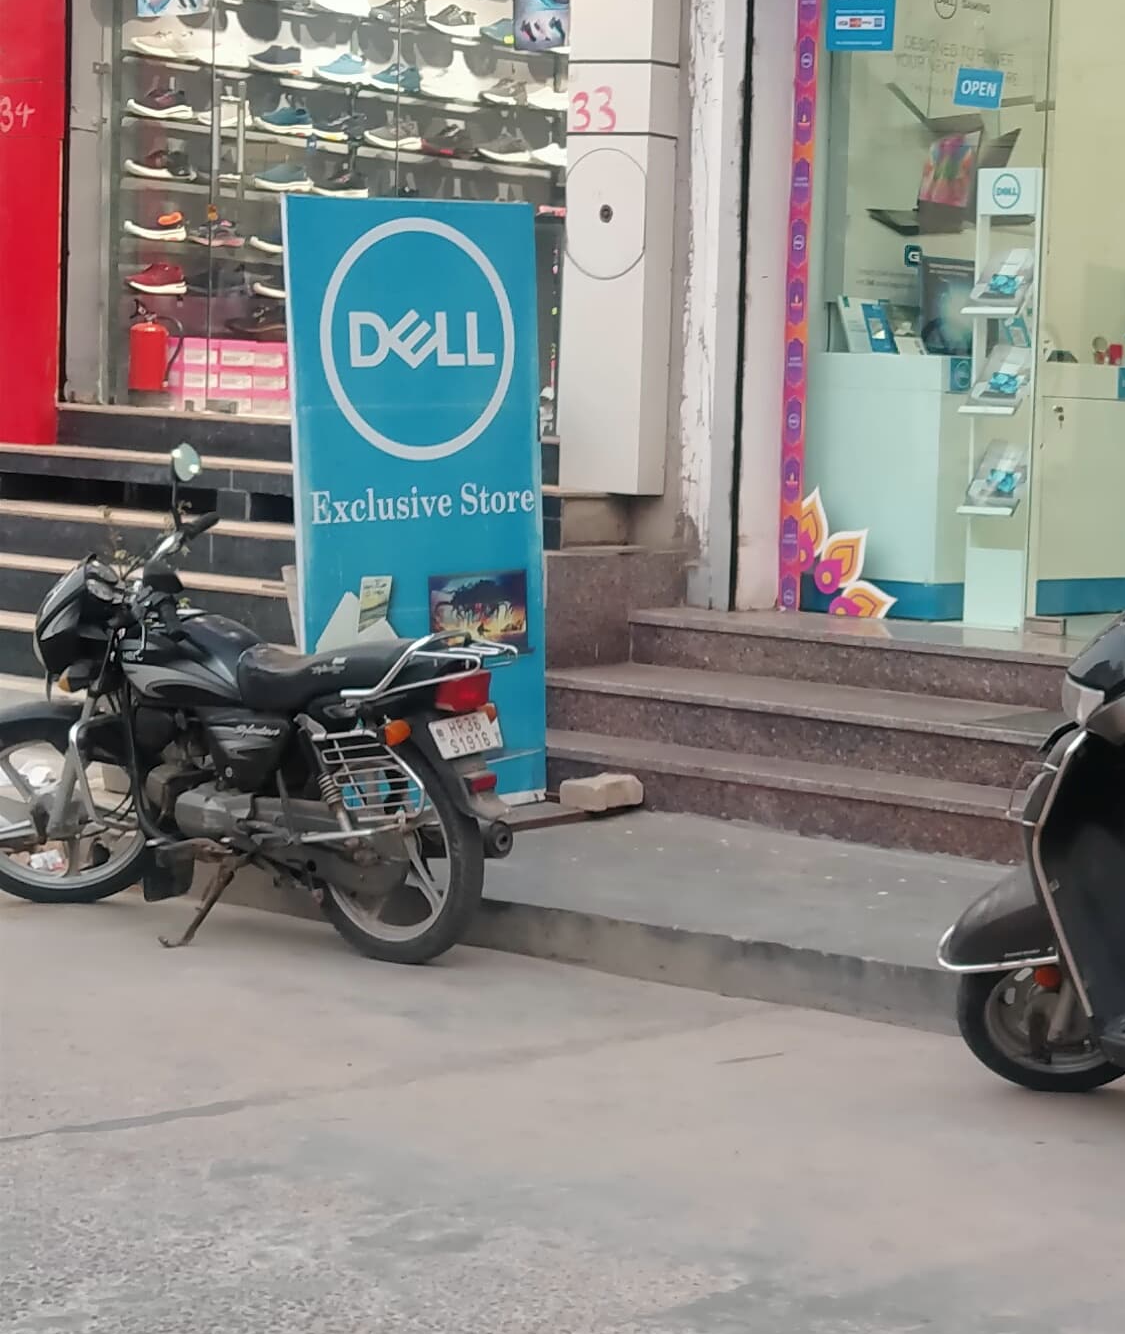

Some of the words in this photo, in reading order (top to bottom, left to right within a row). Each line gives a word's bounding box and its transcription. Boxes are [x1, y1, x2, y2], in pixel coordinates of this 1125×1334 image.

[572, 86, 617, 133] 33
[960, 79, 998, 98] OPEN
[347, 308, 497, 370] DELL
[310, 487, 454, 526] Exclusive
[460, 481, 537, 516] Store
